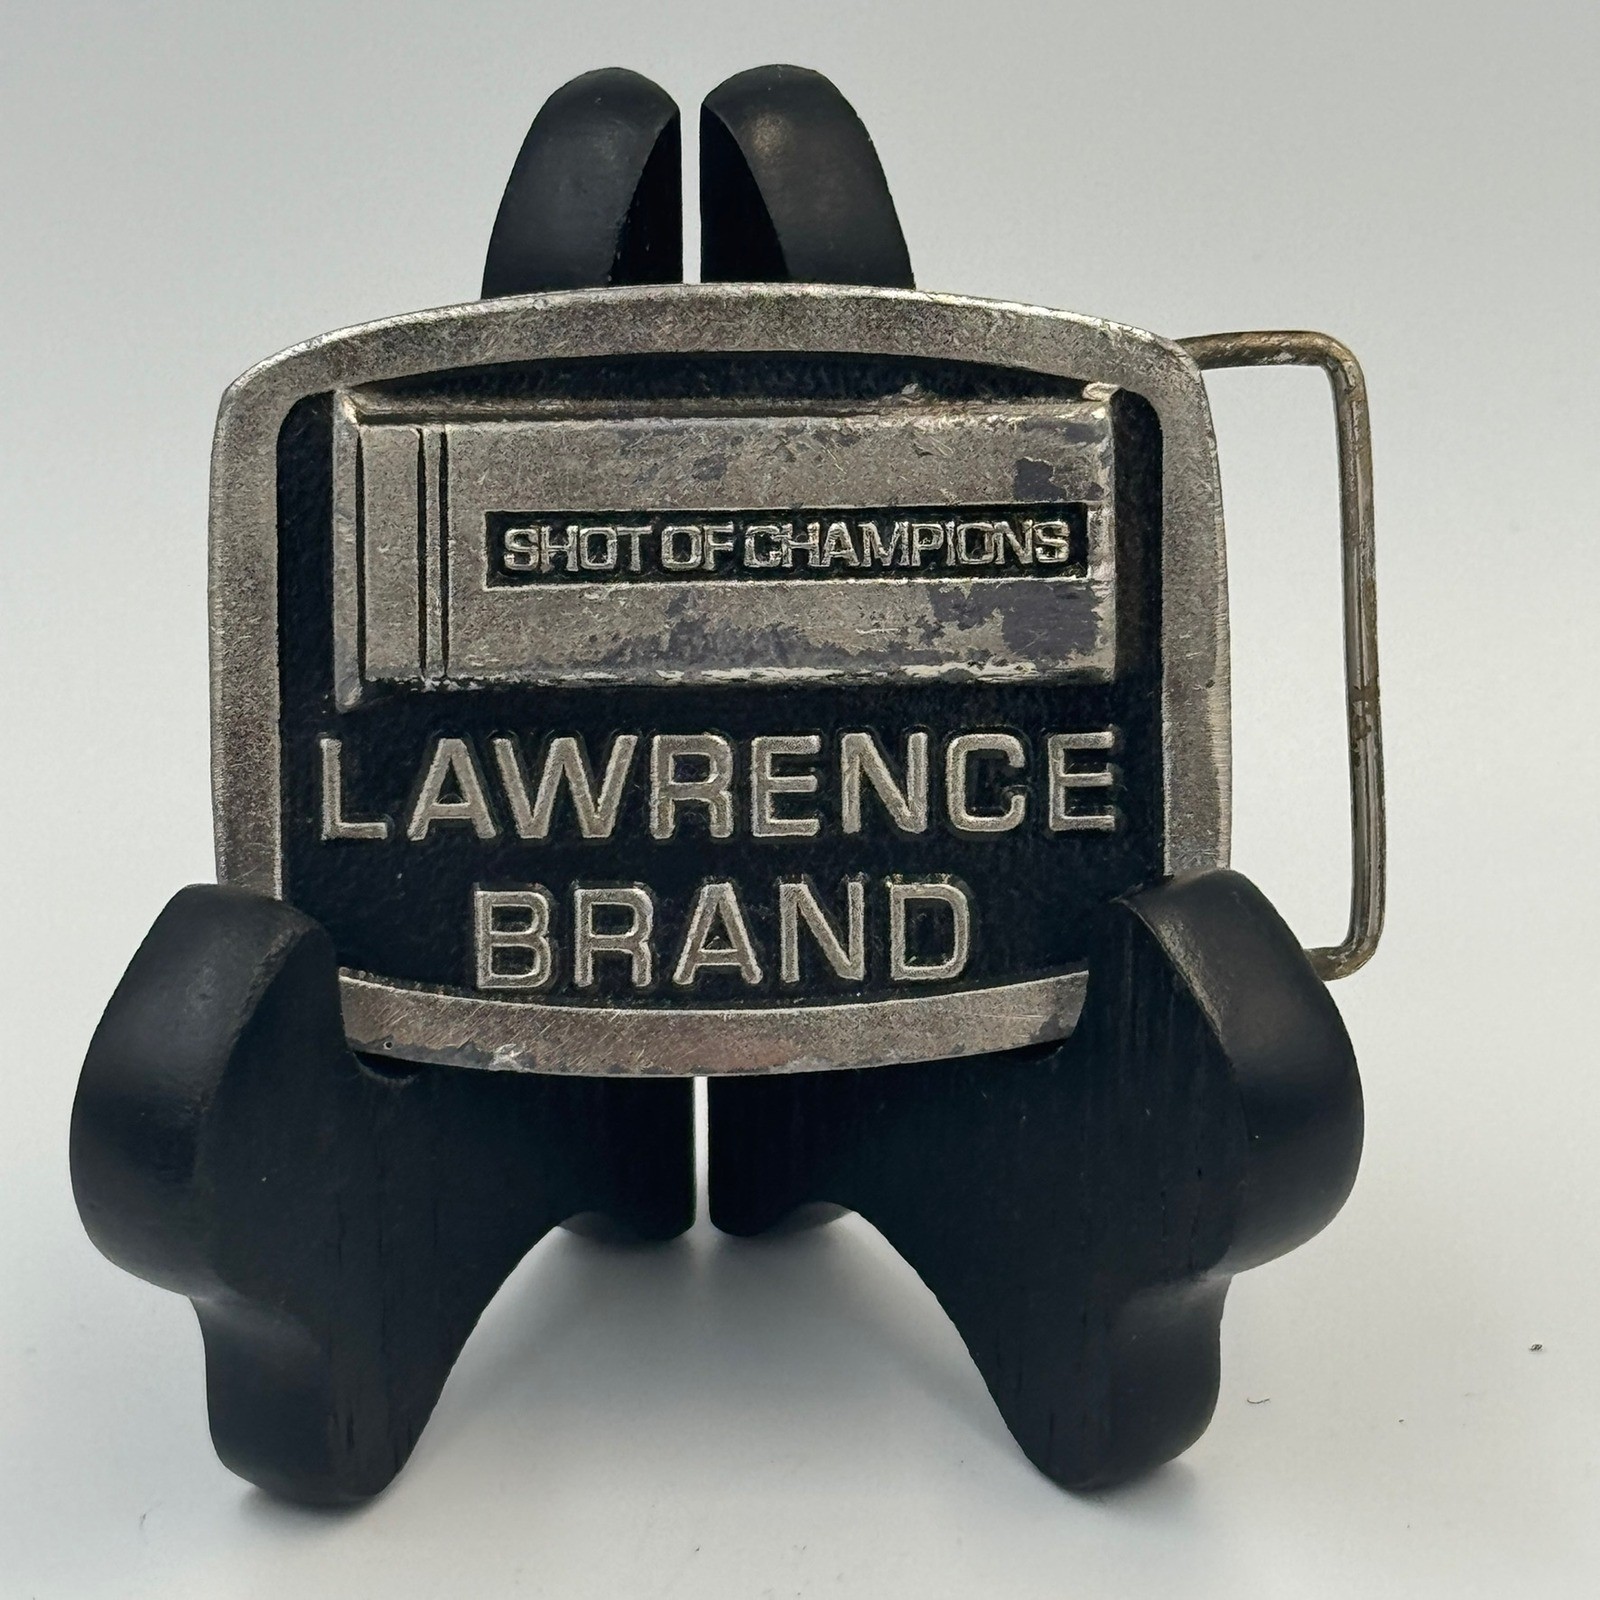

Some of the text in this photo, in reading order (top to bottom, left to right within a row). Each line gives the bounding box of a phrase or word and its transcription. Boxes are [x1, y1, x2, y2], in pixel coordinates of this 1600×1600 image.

[503, 519, 1070, 572] SHOT OF CHAMPIONS
[319, 731, 1118, 842] LAWRENCE
[473, 878, 972, 991] BRAND
